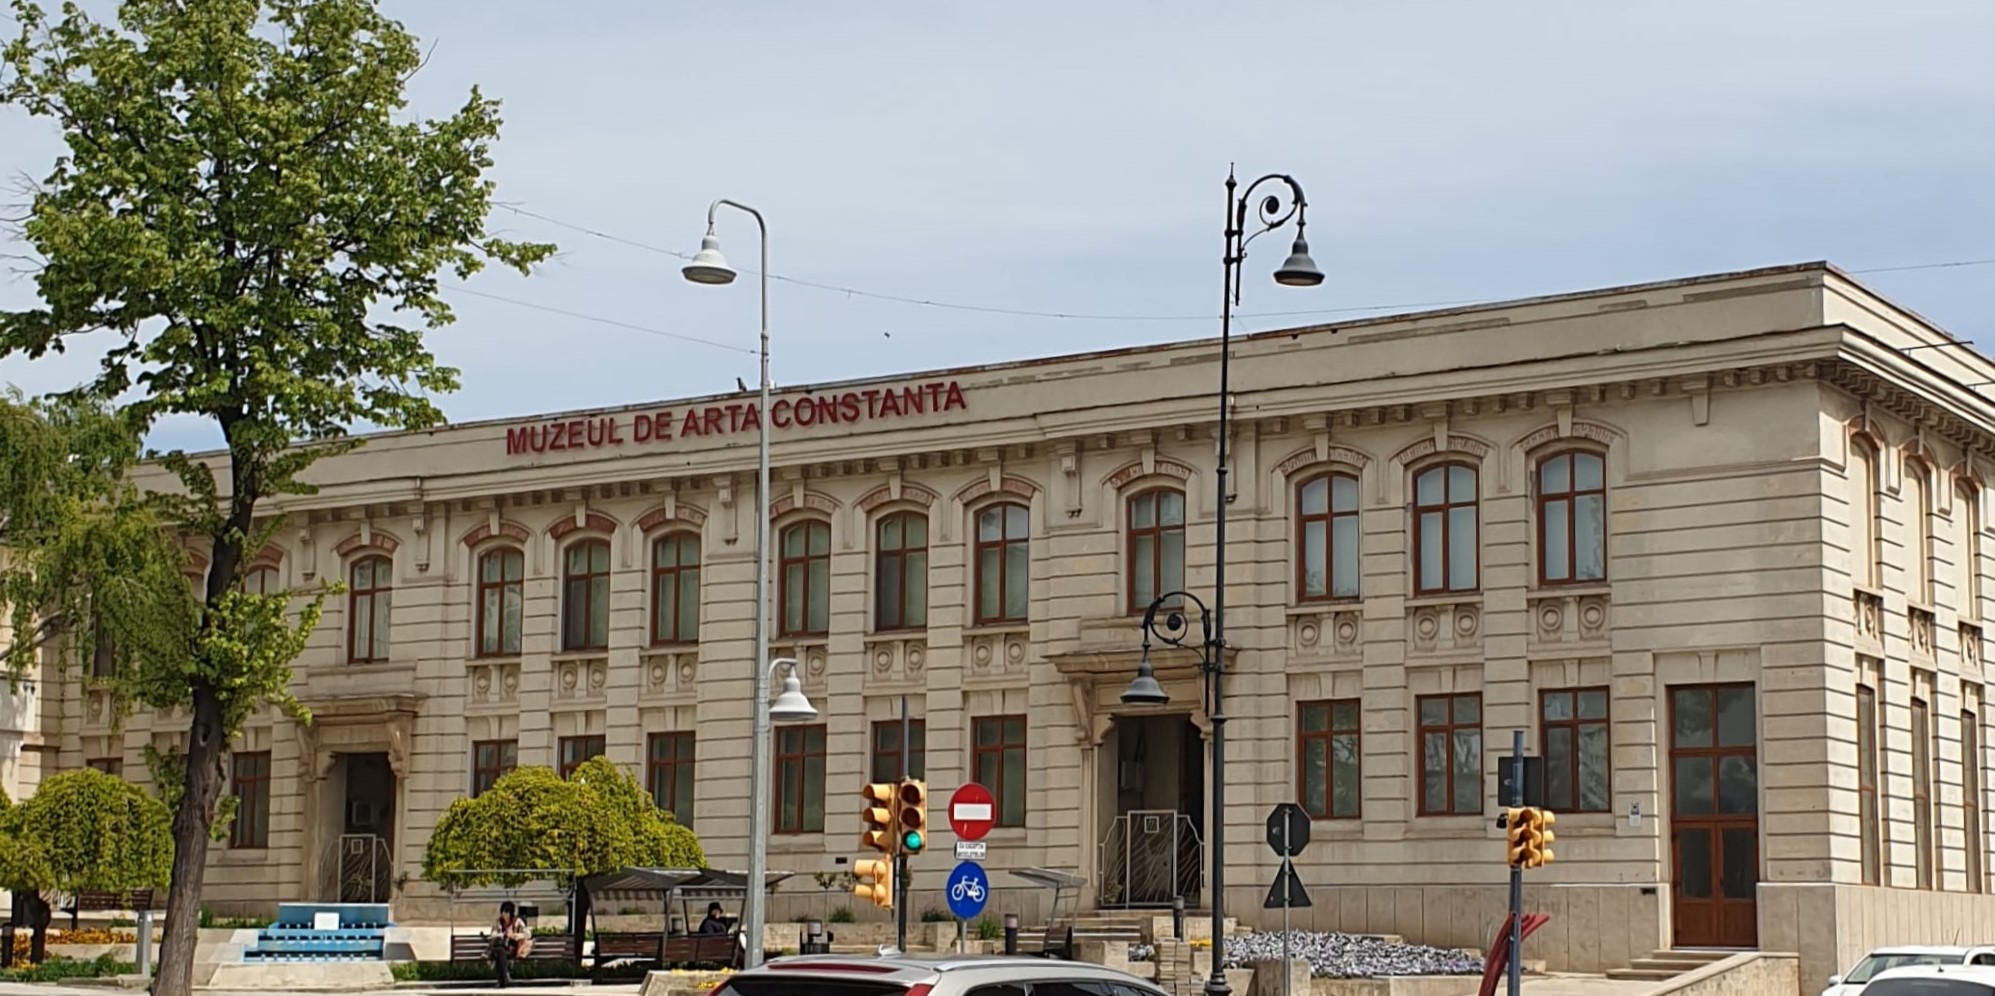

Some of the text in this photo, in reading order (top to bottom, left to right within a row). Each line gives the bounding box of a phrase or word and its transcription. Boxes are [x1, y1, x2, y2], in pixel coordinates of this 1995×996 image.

[506, 381, 967, 455] MUZEUL DE ARTA CONSTANTA
